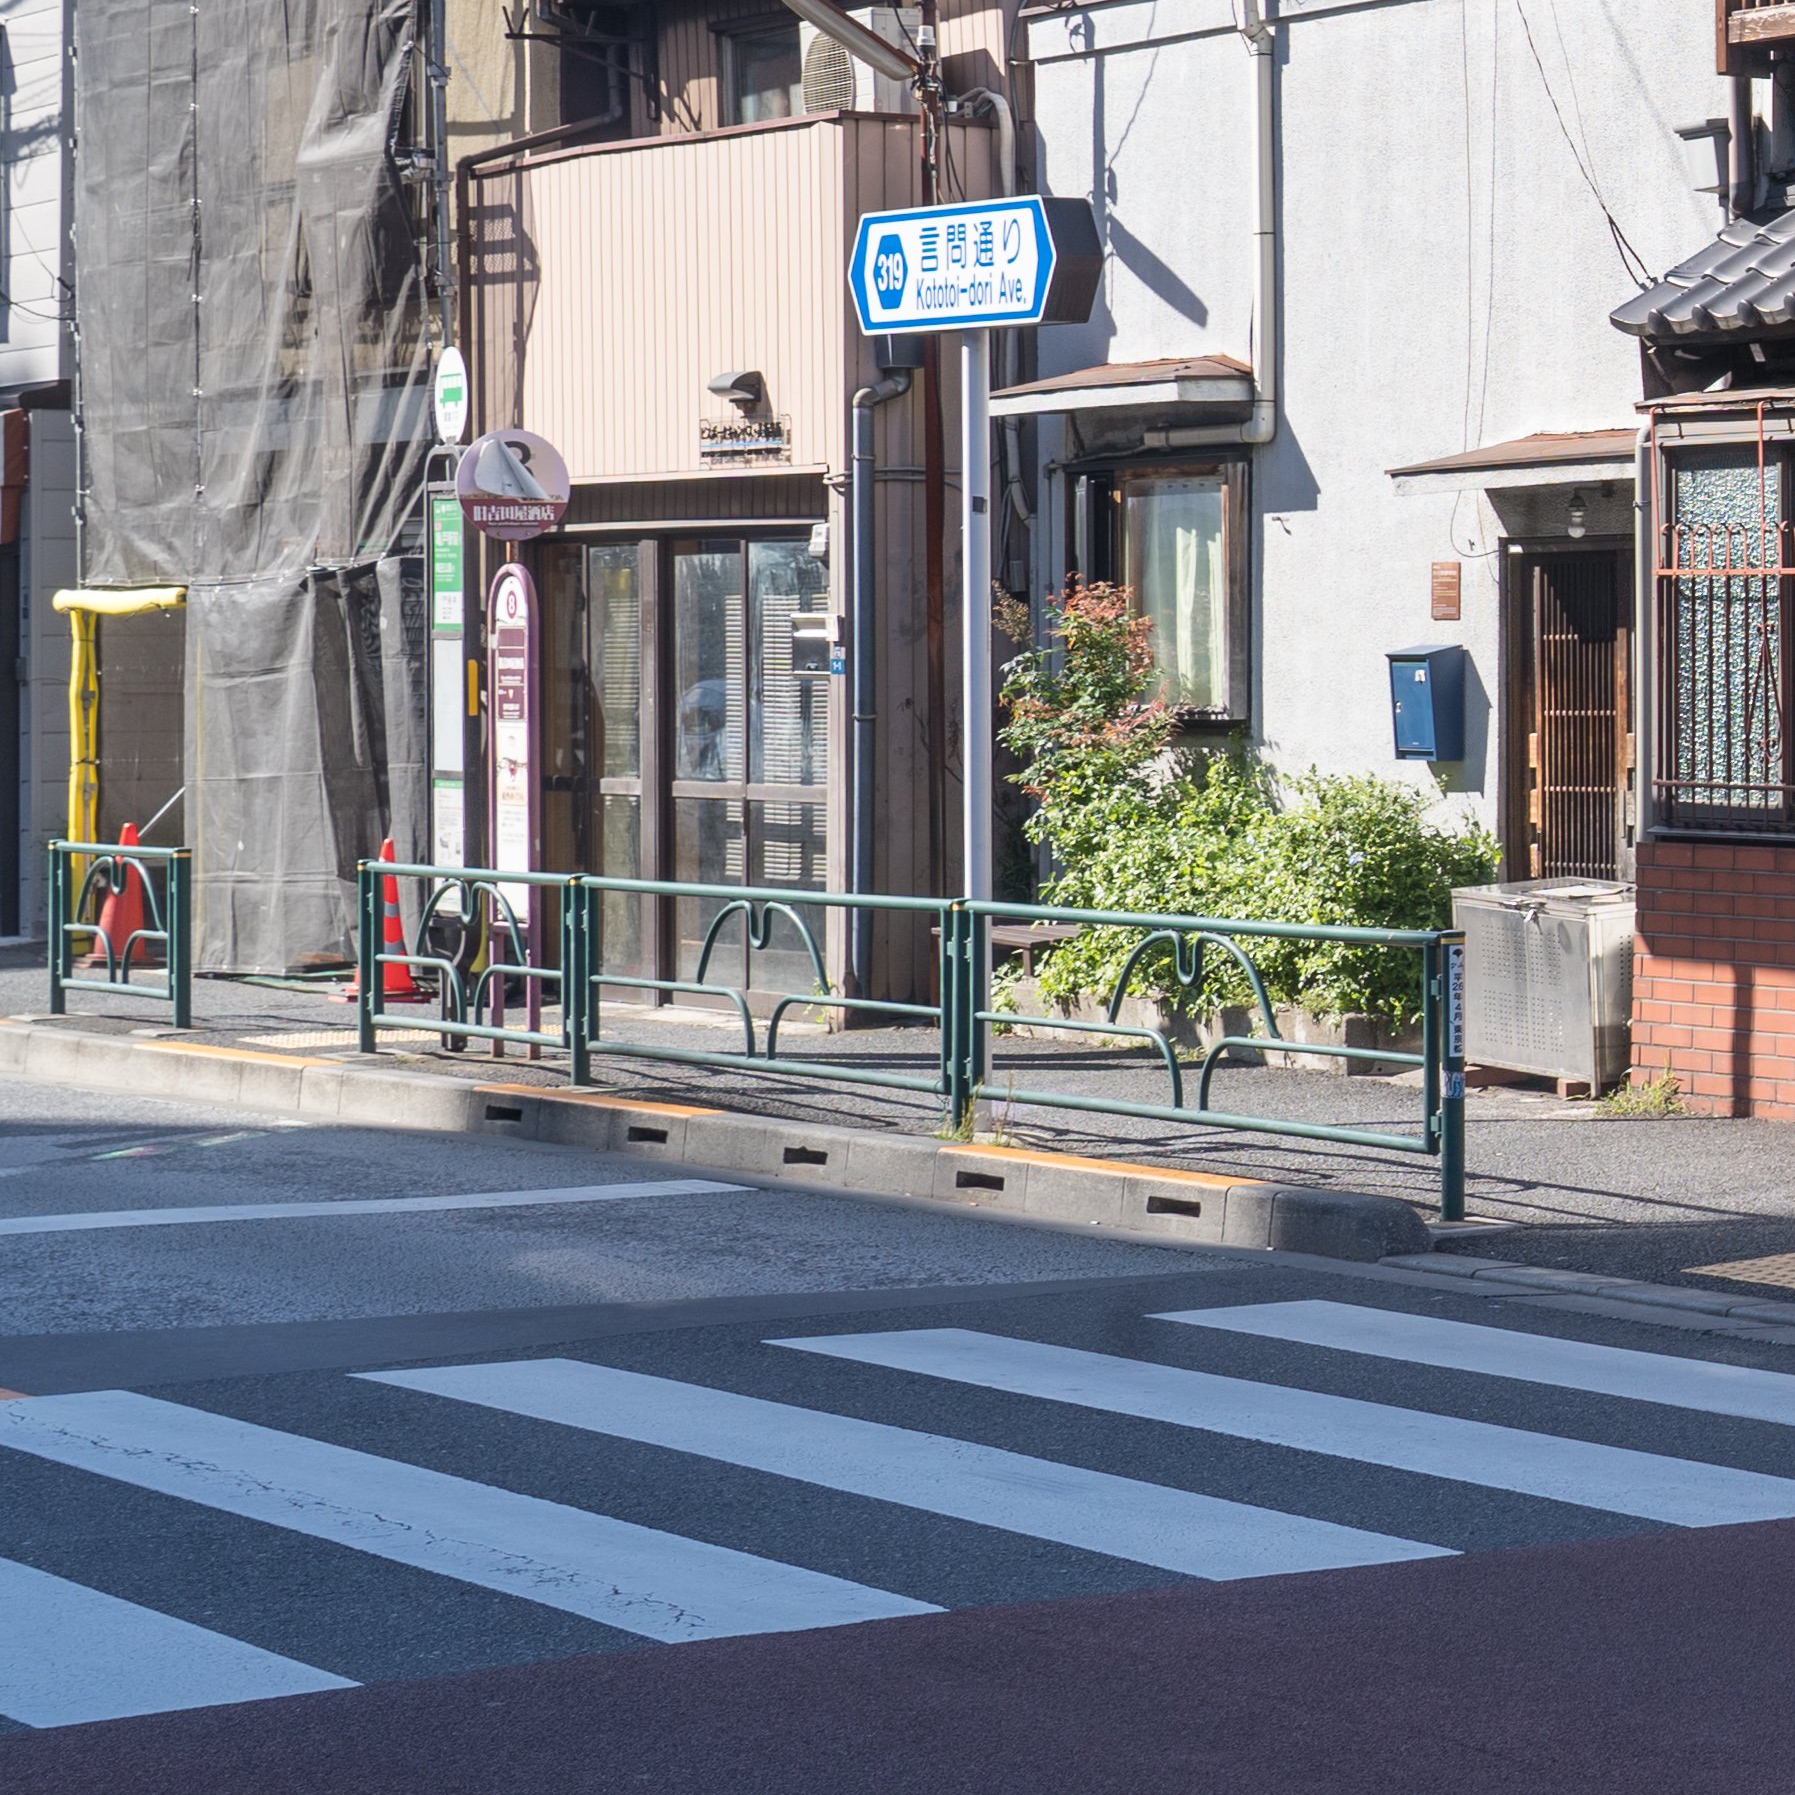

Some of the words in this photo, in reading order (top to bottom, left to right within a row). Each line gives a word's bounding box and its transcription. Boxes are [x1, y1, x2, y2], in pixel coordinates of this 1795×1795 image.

[919, 218, 1021, 273] 言問通り
[877, 252, 904, 292] 319
[916, 273, 993, 311] Kototoi-dori
[999, 271, 1027, 305] Ave.
